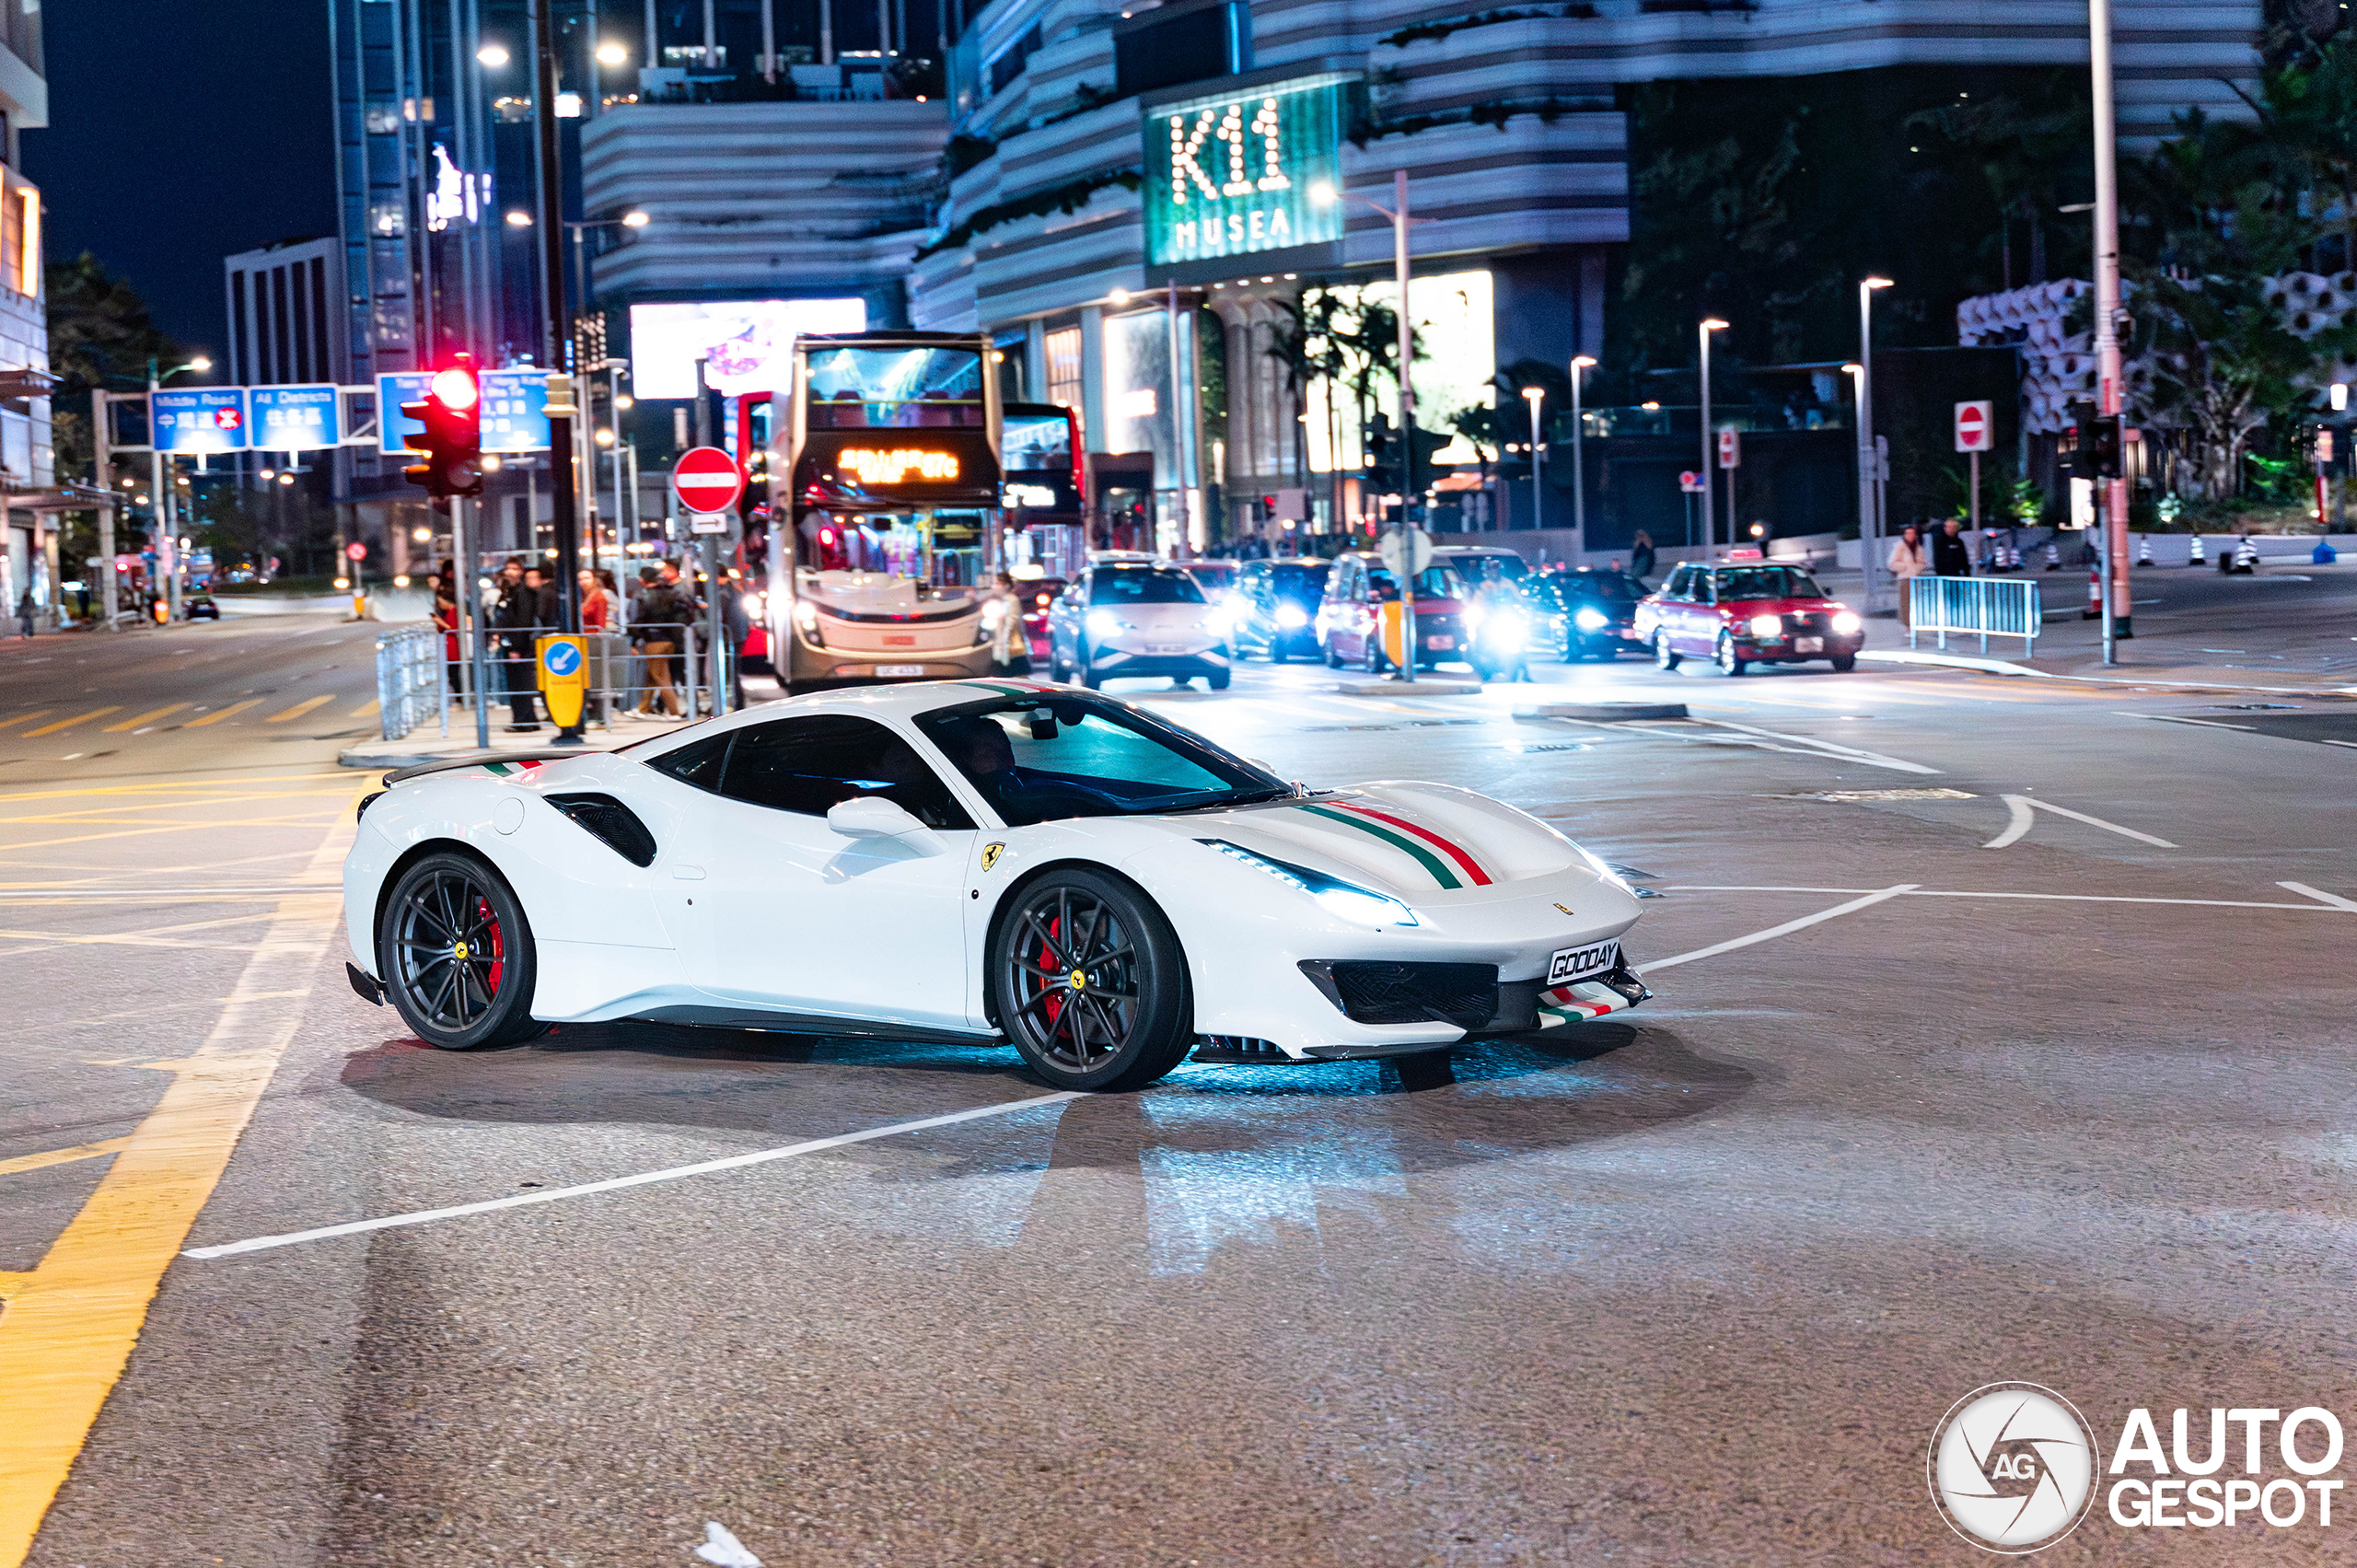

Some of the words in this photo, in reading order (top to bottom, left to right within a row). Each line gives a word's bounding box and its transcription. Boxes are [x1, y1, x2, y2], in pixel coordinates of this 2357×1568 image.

[1170, 98, 1291, 204] K11
[1176, 208, 1290, 249] MUSEA
[1551, 942, 1618, 979] GOODAY
